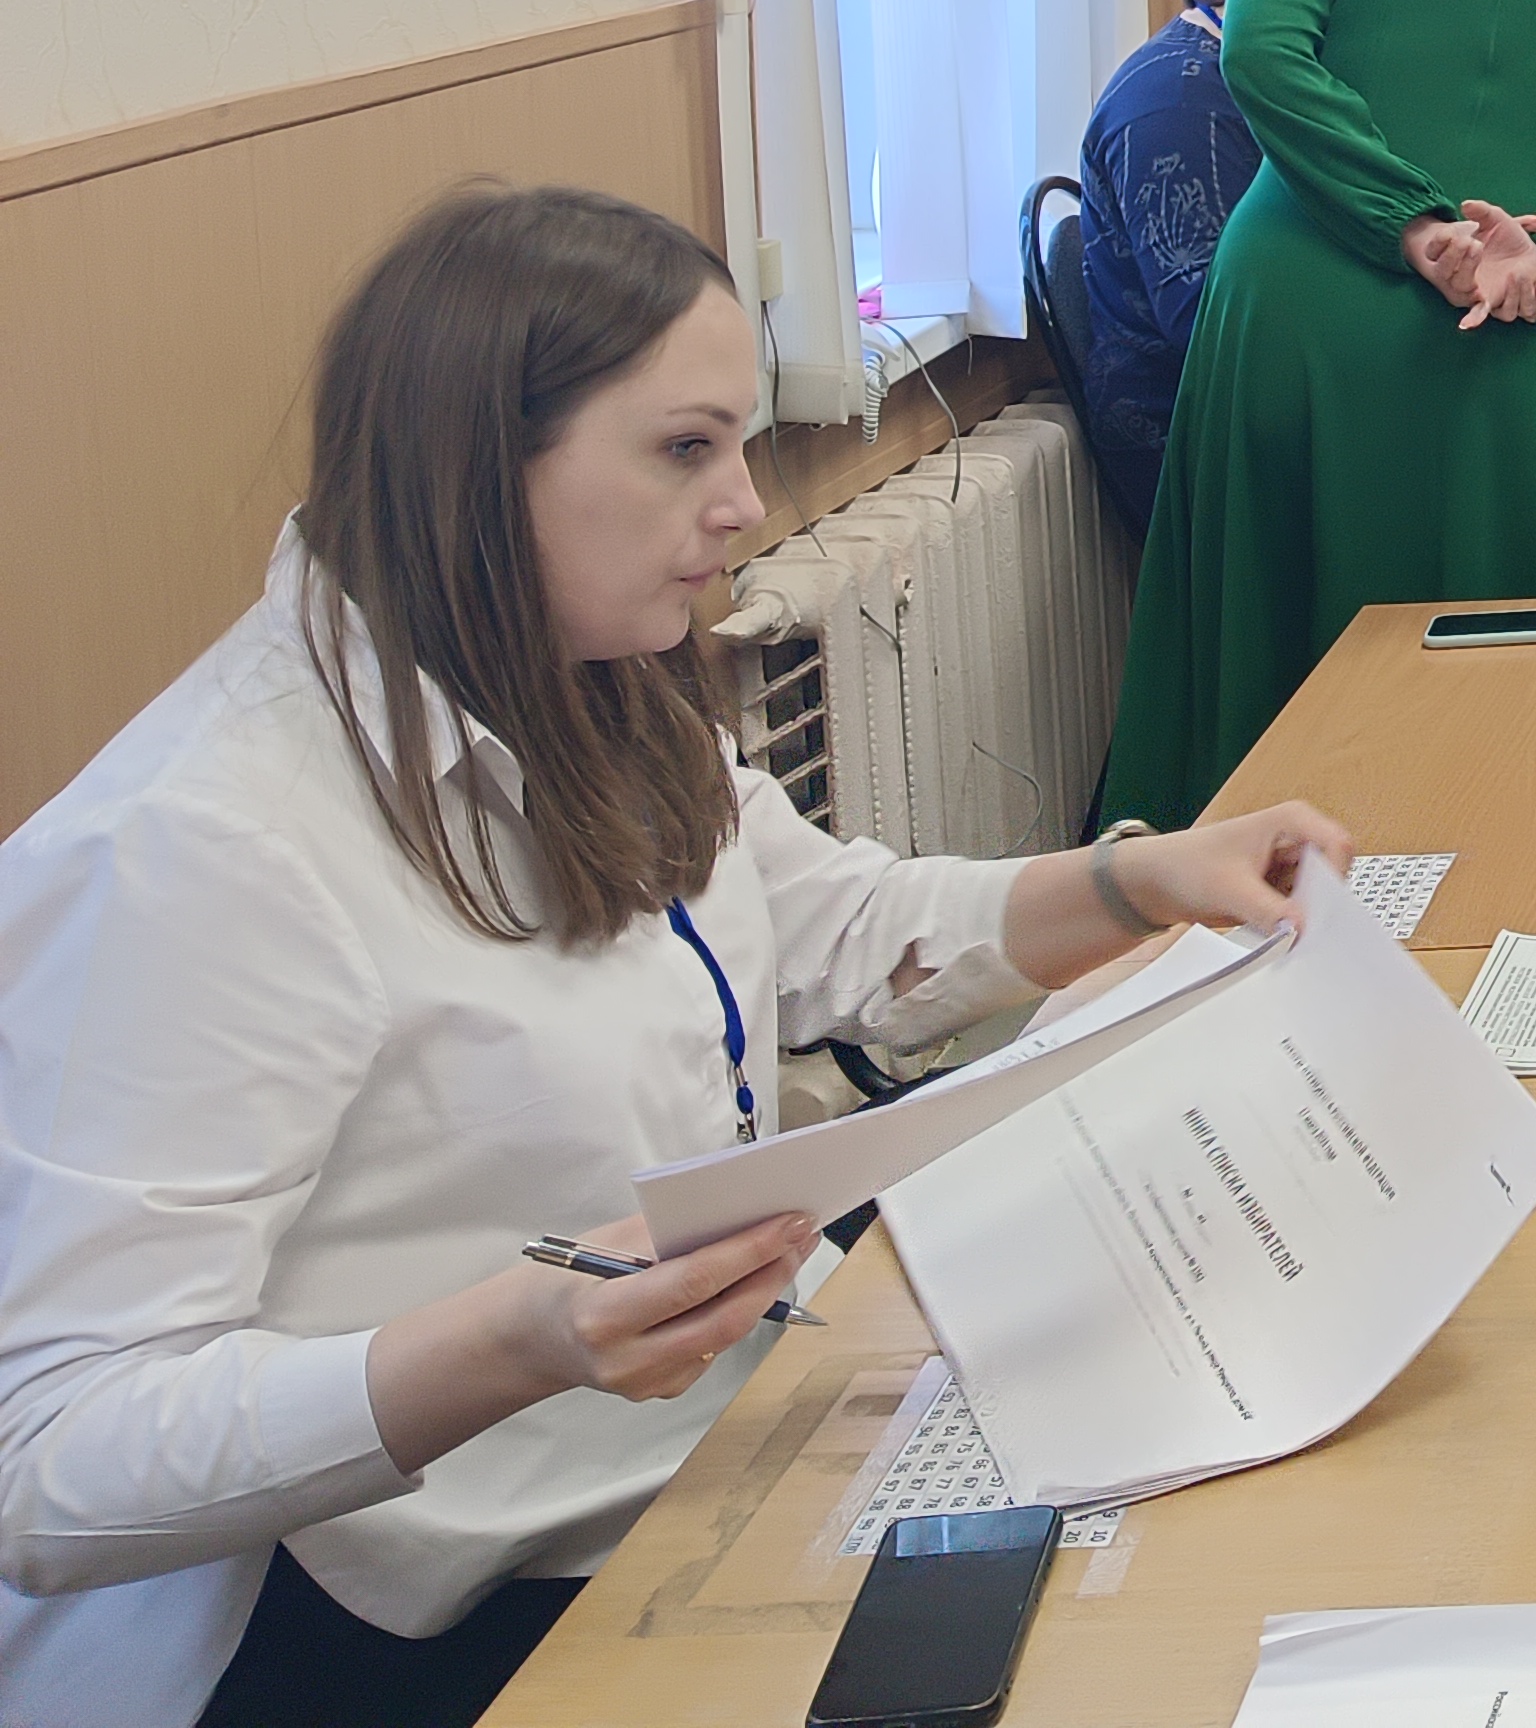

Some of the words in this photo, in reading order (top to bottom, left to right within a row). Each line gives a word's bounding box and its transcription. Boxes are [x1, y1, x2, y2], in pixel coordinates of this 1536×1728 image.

[1236, 1192, 1306, 1284] ИЗБИРАТЕЛЕЙ
[957, 1442, 976, 1453] 75
[882, 1479, 900, 1492] 97
[935, 1477, 953, 1489] 77
[962, 1476, 979, 1489] 67
[976, 1494, 995, 1507] 58
[1063, 1530, 1081, 1543] 20
[1090, 1530, 1108, 1542] 10
